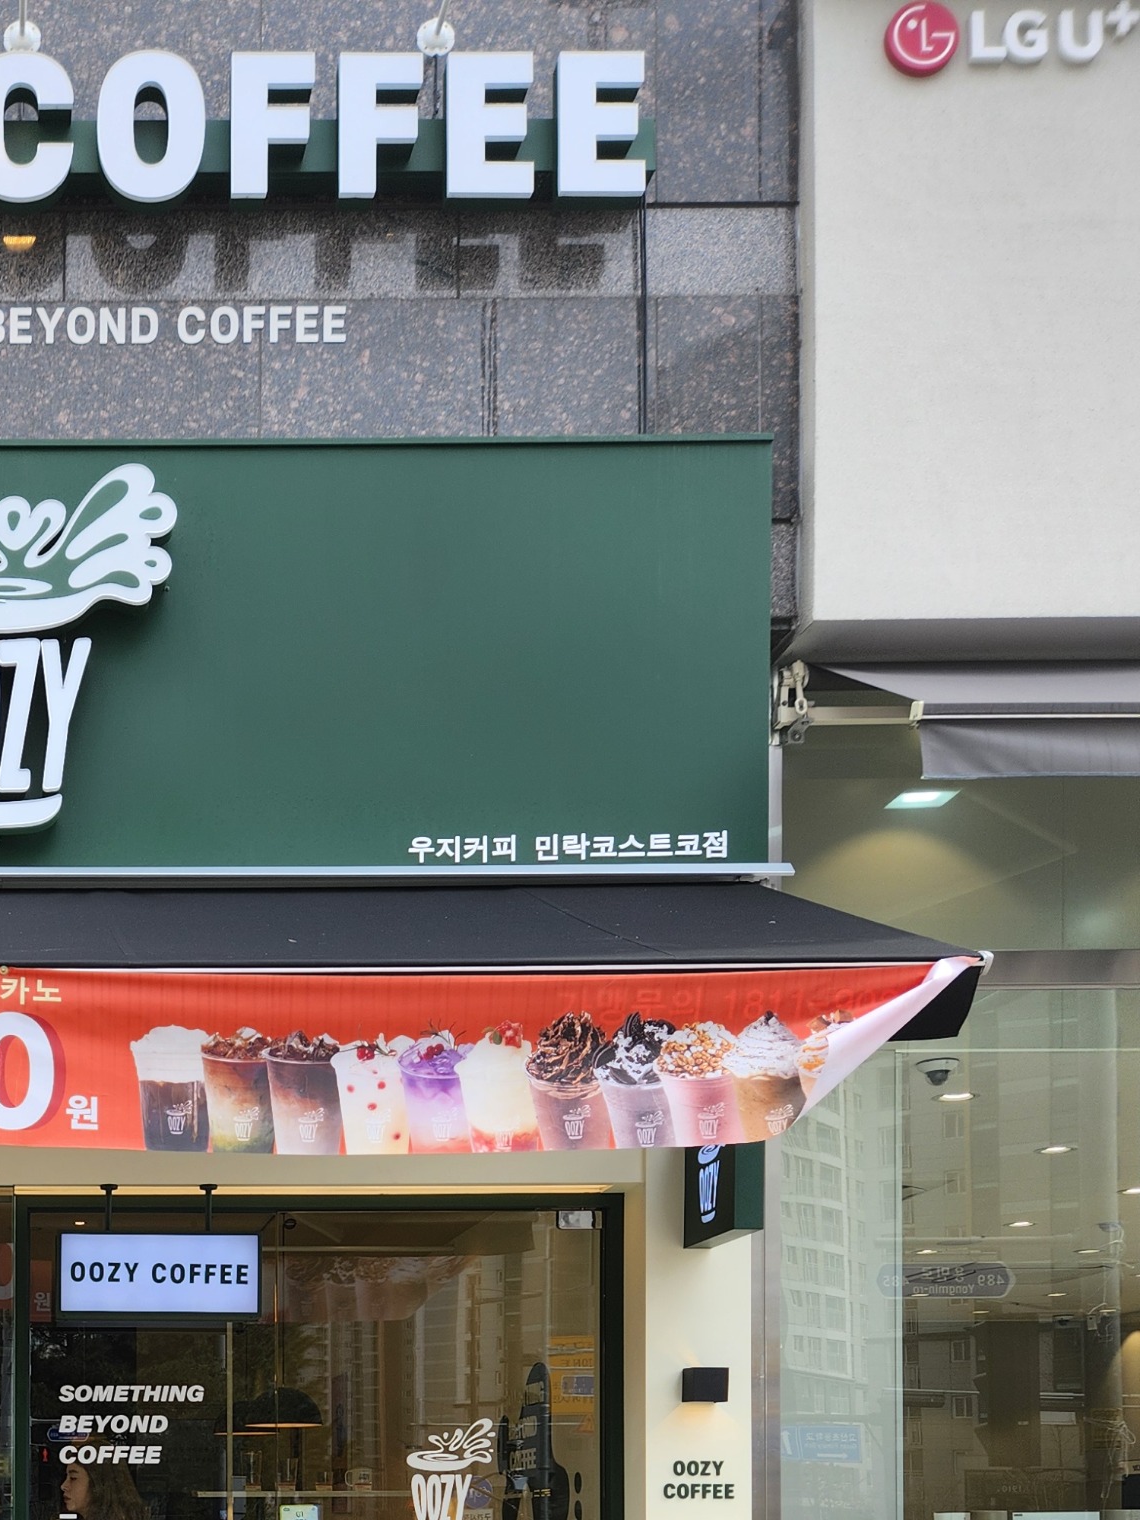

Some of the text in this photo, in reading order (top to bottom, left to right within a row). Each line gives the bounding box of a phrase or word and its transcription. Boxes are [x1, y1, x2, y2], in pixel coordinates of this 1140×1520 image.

[176, 305, 348, 345] COFFEE
[408, 829, 729, 863] 우지커피 민락코스트코점
[65, 1094, 100, 1131] 원
[70, 1261, 249, 1285] OOZY COFFEE
[59, 1384, 205, 1403] SOMETHING
[59, 1414, 169, 1434] BEYOND
[59, 1445, 162, 1465] COFFEE
[673, 1460, 725, 1476] OOZY
[663, 1483, 735, 1499] COFFEE
